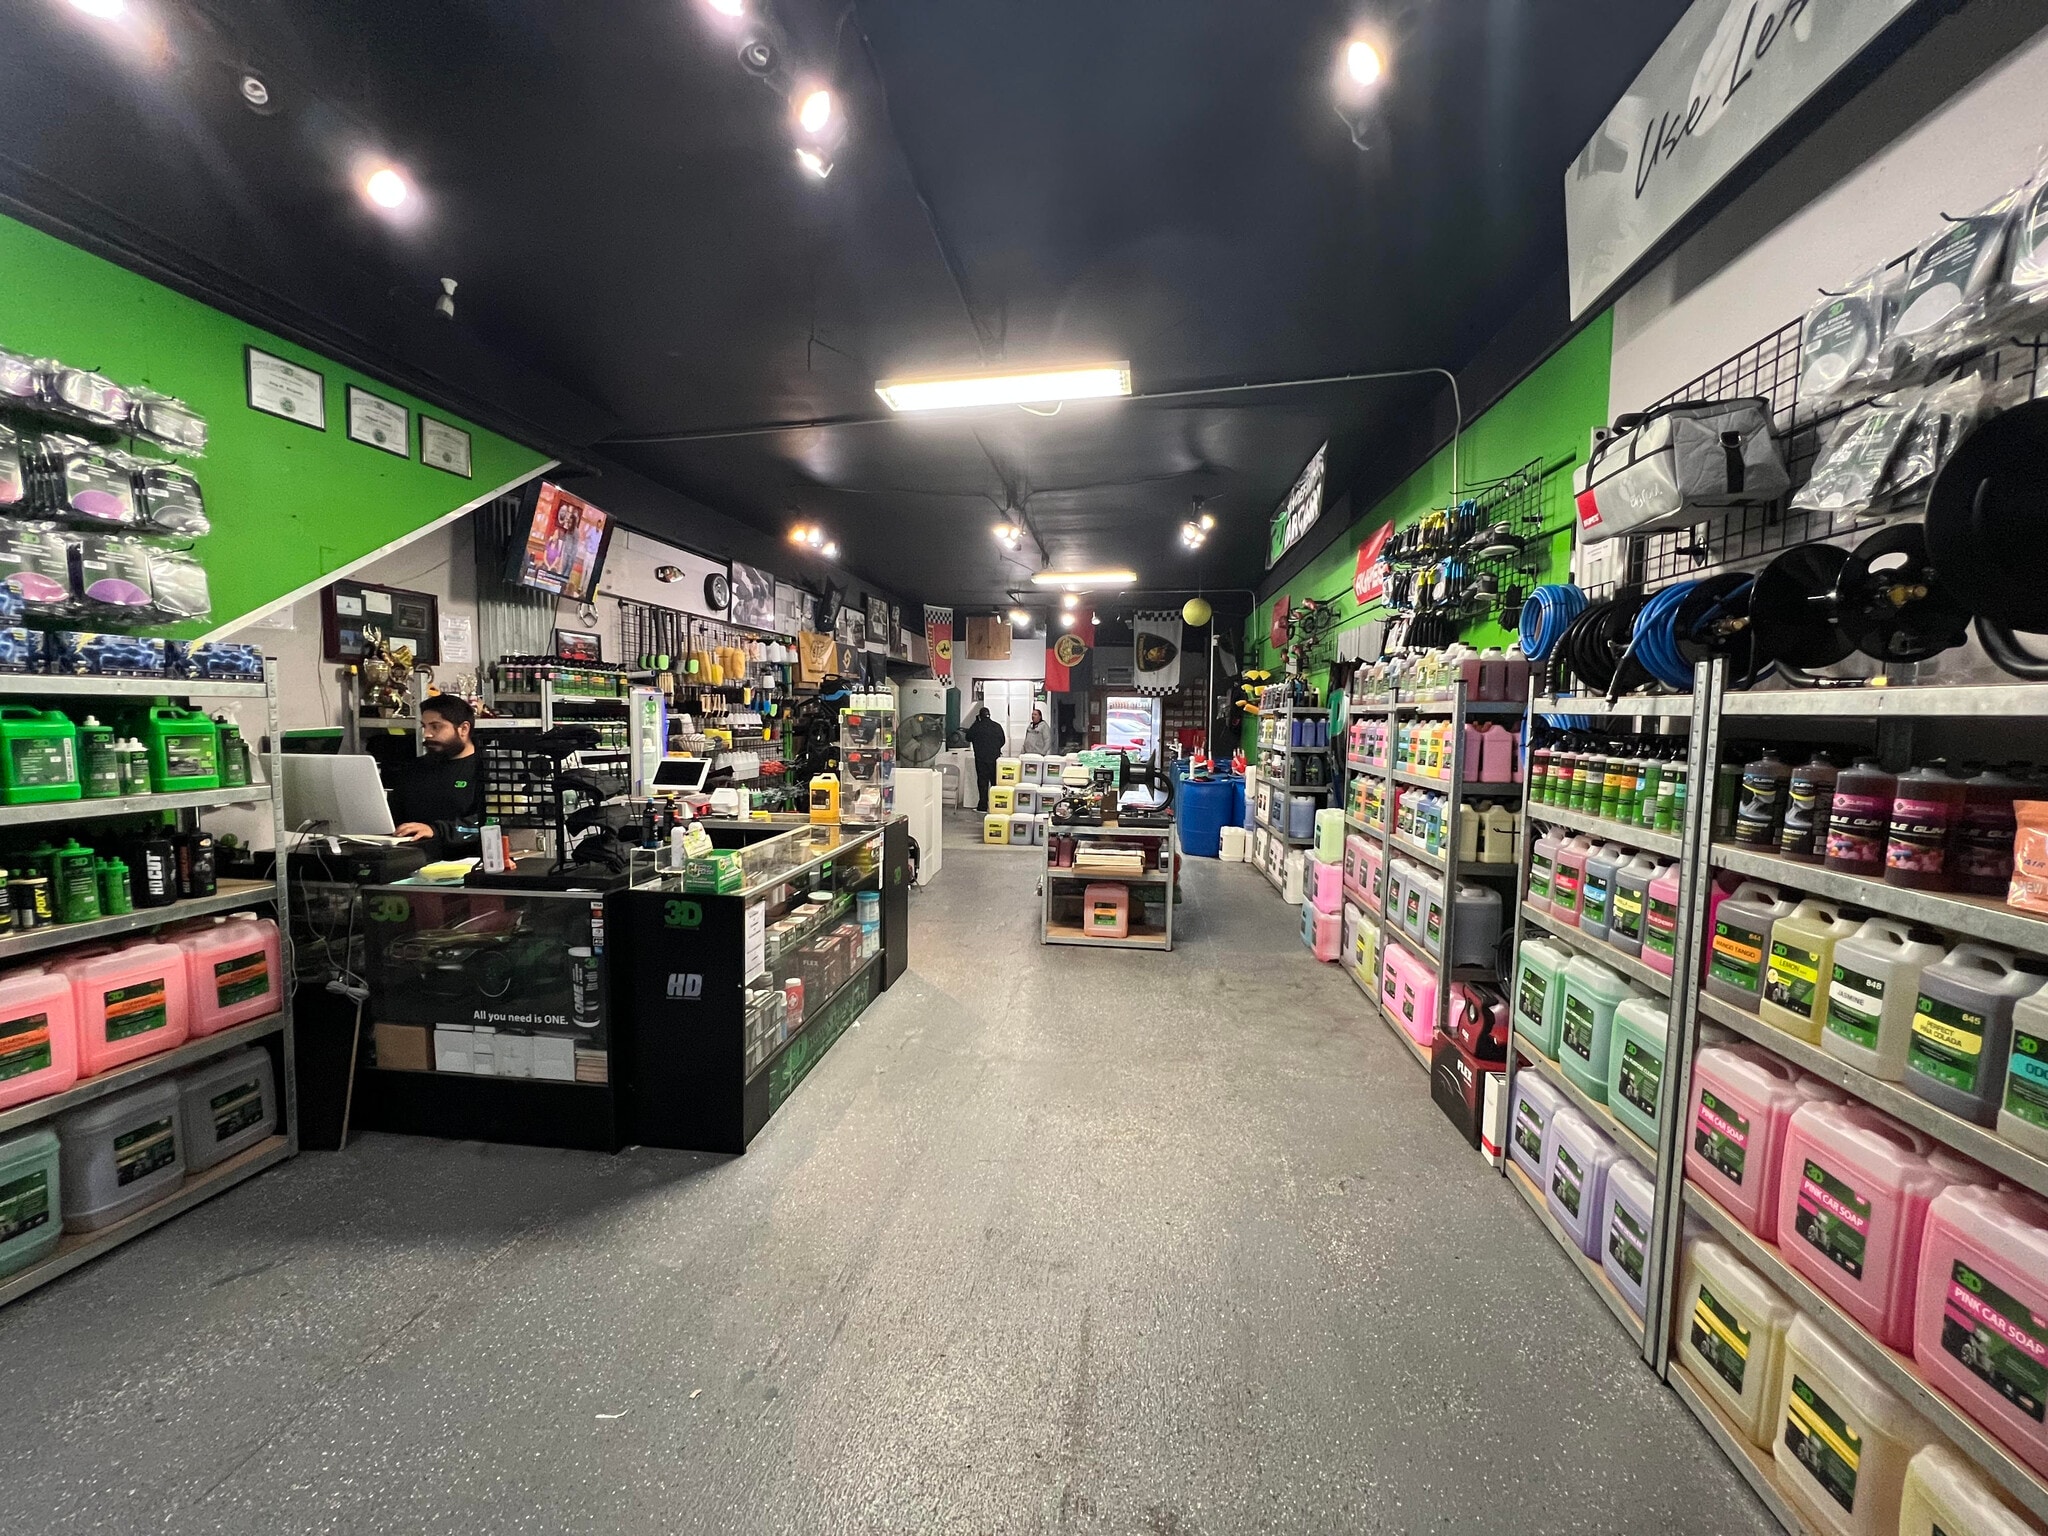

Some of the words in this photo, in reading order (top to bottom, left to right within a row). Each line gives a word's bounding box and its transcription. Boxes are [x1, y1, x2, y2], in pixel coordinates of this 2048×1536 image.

[1636, 94, 1712, 199] Use
[454, 780, 468, 788] 3D
[1912, 825, 1947, 835] GUM
[2024, 858, 2046, 869] AIR
[370, 895, 410, 923] 3D
[664, 899, 703, 927] 3D
[1716, 922, 1728, 936] 3D
[1734, 944, 1756, 959] TANGO
[1773, 943, 1787, 956] 3D
[1779, 959, 1800, 973] LEMON
[666, 973, 703, 997] HD
[1865, 978, 1882, 990] 848
[473, 1010, 487, 1020] All
[488, 1013, 507, 1023] you
[508, 1012, 532, 1024] need
[534, 1014, 543, 1024] is
[544, 1014, 569, 1026] ONE.
[1926, 1019, 1955, 1036] PERFECT
[1933, 1031, 1962, 1047] COLADA
[2016, 1035, 2038, 1054] 3D
[1457, 1058, 1472, 1084] FLEX
[1703, 1093, 1716, 1109] 3D
[1702, 1107, 1715, 1123] PINK
[1714, 1117, 1727, 1133] CAR
[1727, 1125, 1745, 1143] SOAP
[1806, 1164, 1824, 1184] 3D
[1804, 1180, 1823, 1202] PINK
[1822, 1194, 1839, 1212] CAR
[1839, 1204, 1864, 1228] SOAP
[1956, 1266, 1982, 1293] 3D
[1954, 1287, 1982, 1313] PINK
[1981, 1307, 2007, 1332] CAR
[2008, 1326, 2045, 1355] SOAP
